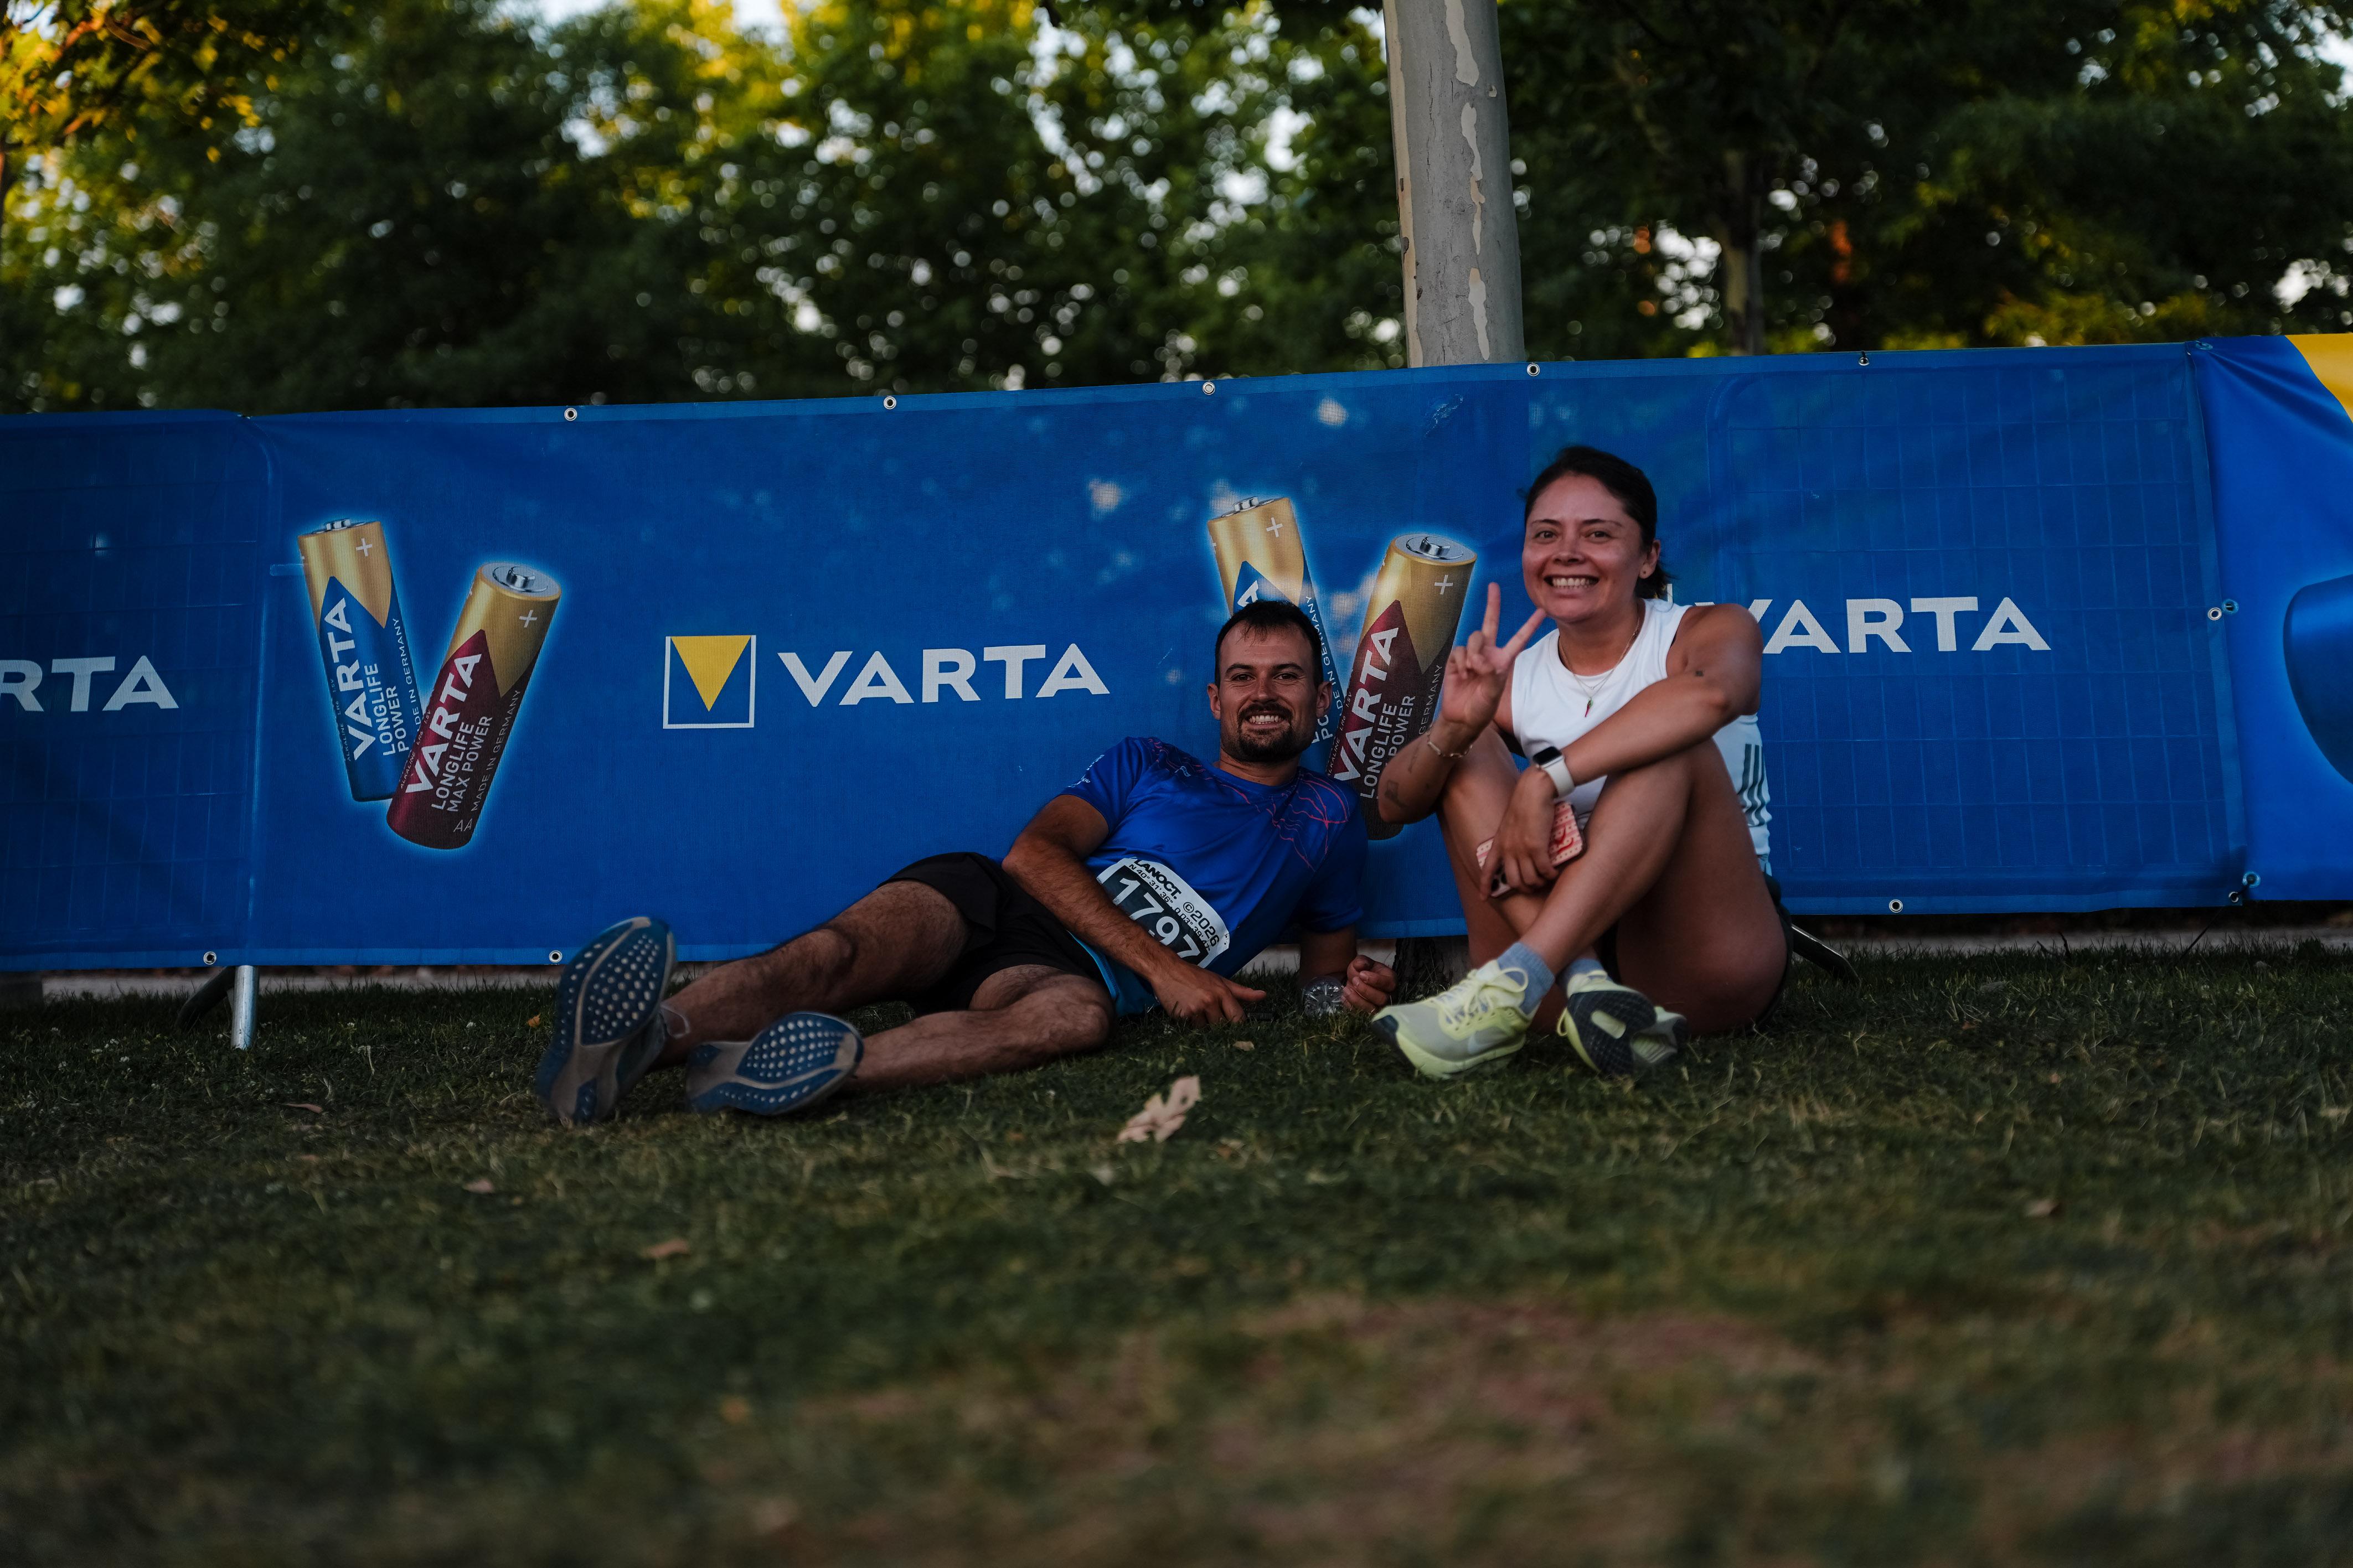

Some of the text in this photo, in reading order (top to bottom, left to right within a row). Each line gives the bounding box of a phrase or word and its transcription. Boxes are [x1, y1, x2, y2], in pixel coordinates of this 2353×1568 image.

[324, 597, 376, 761] VARTA
[393, 618, 413, 684] GERMANY
[777, 643, 1110, 707] VARTA
[364, 663, 396, 755] LONGLIFE
[385, 685, 410, 753] POWER
[405, 654, 482, 793] VARTA
[409, 689, 416, 703] IN
[1333, 627, 1399, 781] VARTA
[1388, 695, 1416, 757] POWER
[1418, 665, 1443, 734] GERMANY
[341, 723, 351, 762] ALKALINE
[401, 752, 416, 789] ALKALINE
[431, 722, 474, 810] LONGLIFE
[447, 716, 493, 812] MAX POWER
[471, 690, 520, 812] MADE IN GERMANY
[1360, 703, 1397, 799] LONGLIFE
[1112, 877, 1201, 959] 1797
